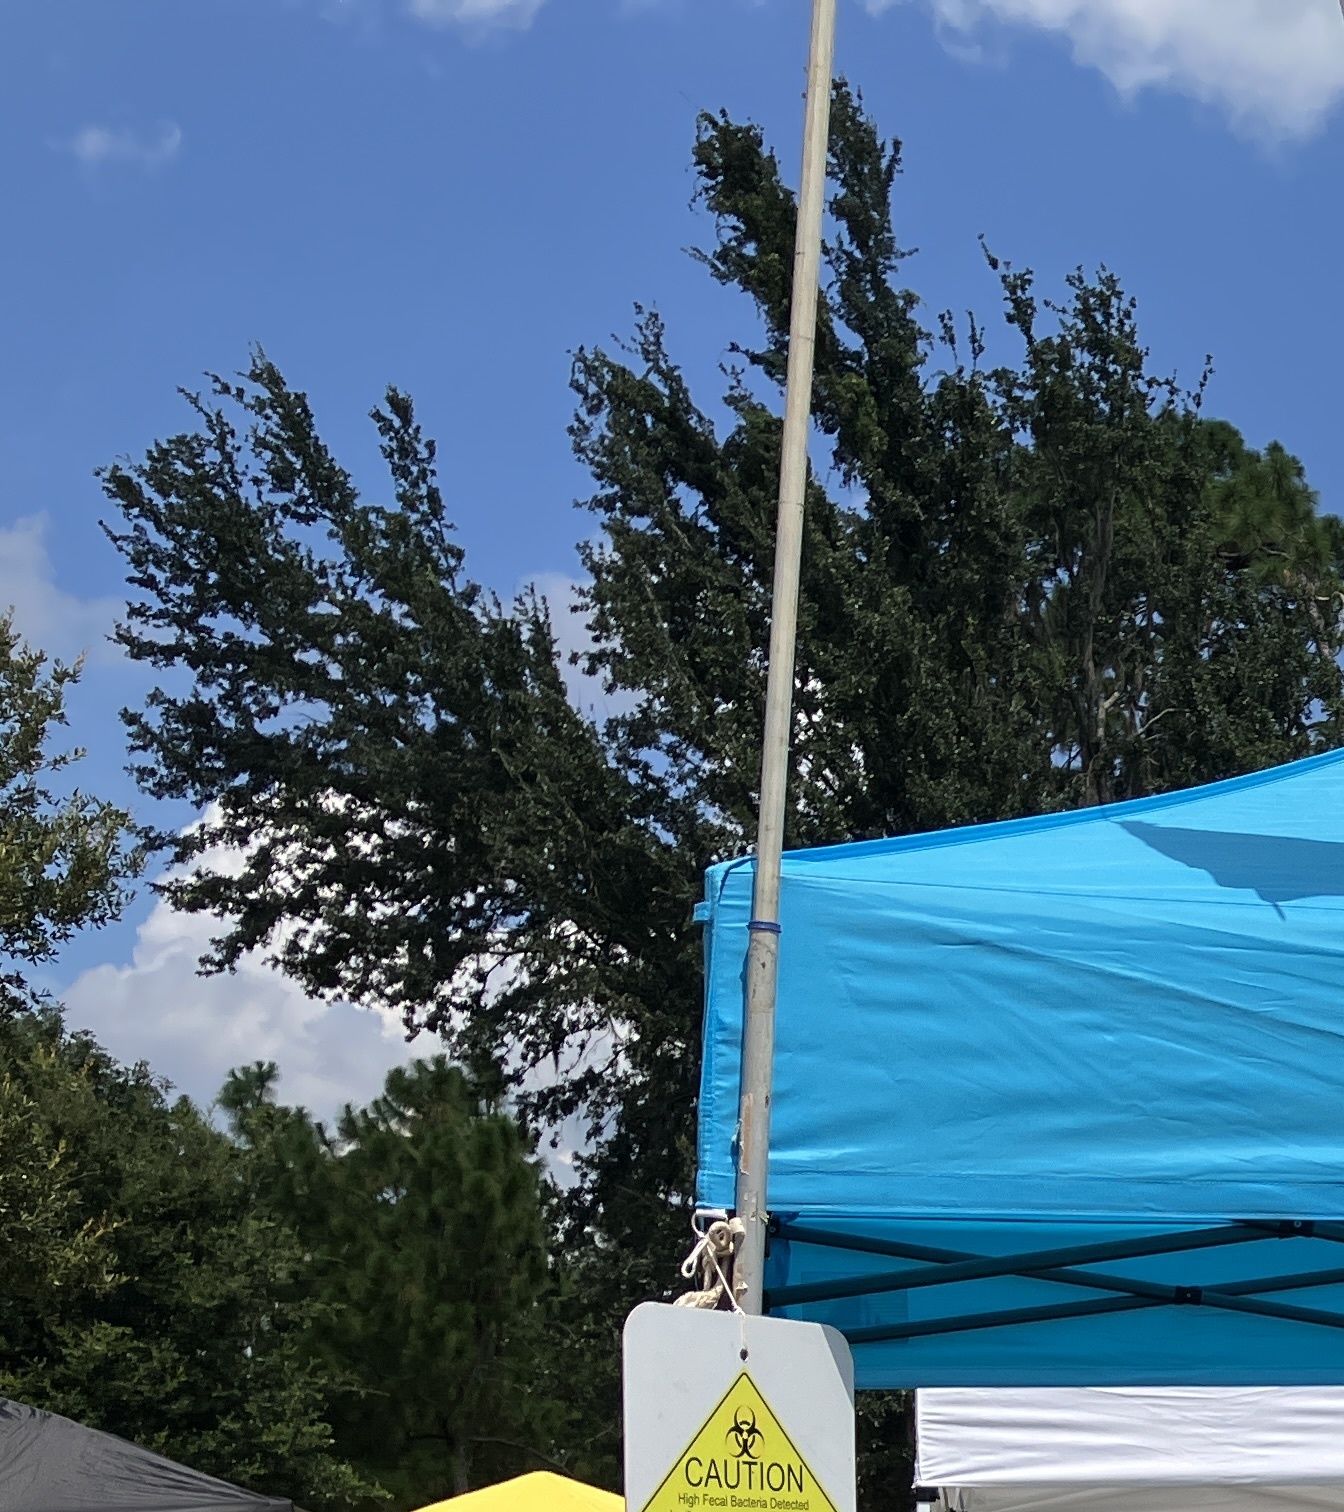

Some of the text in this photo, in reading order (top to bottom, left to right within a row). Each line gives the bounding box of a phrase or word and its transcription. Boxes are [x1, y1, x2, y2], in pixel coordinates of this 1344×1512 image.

[685, 1457, 804, 1493] CAUTION
[678, 1493, 809, 1511] High Fecal Bacteria Detected
